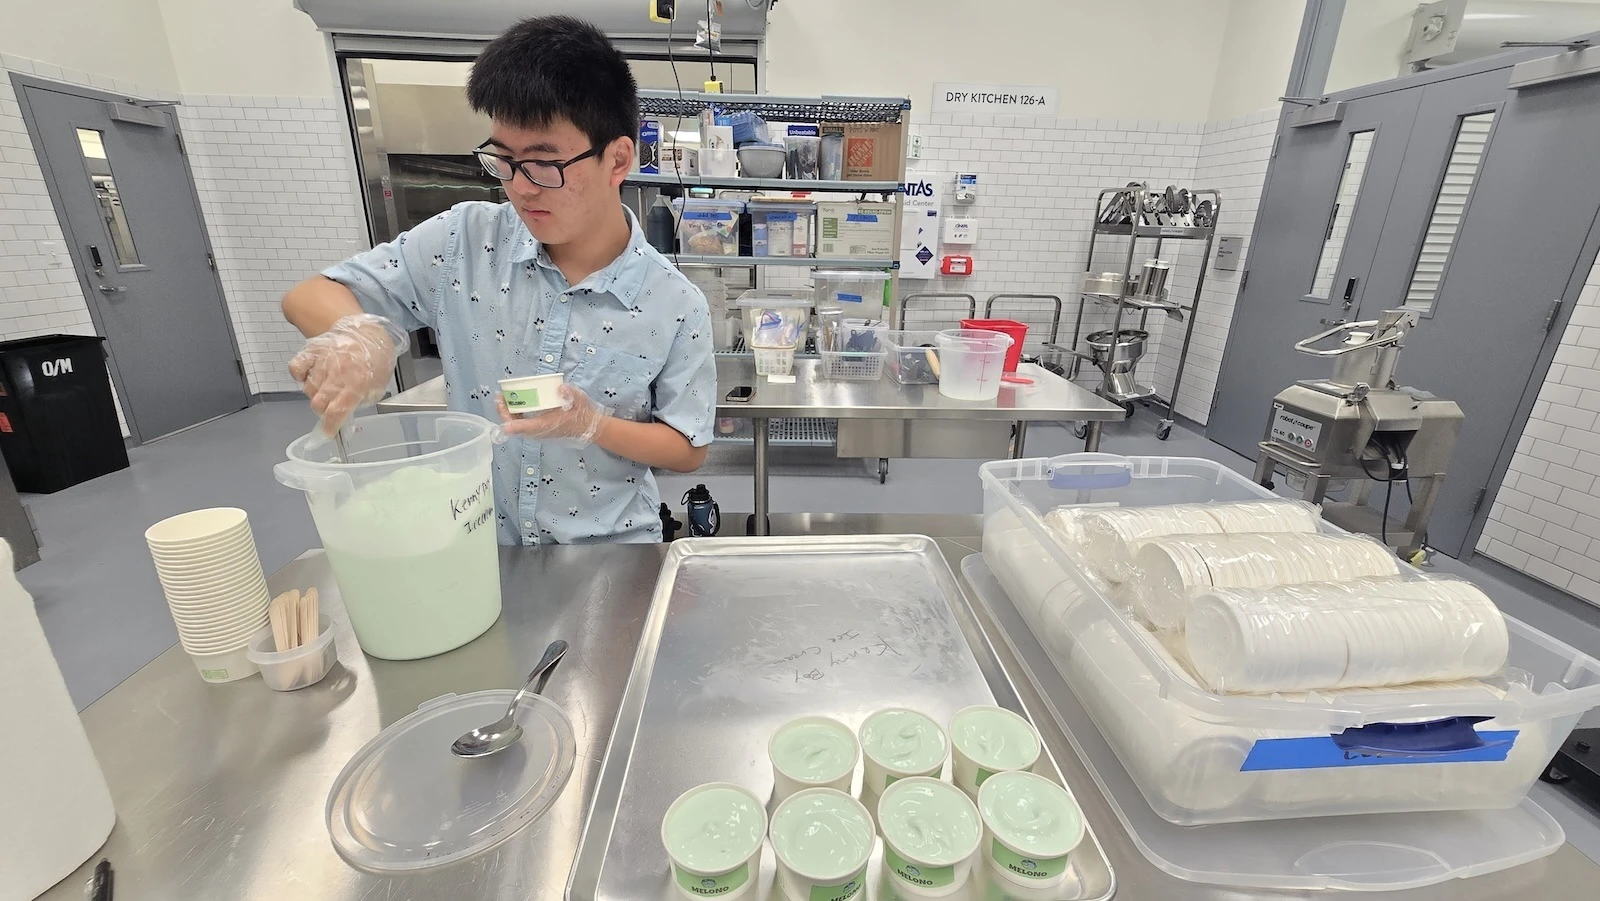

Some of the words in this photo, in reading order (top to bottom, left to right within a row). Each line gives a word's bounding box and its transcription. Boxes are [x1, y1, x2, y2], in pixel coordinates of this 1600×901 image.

[946, 92, 968, 102] DRY
[970, 93, 1017, 105] KITCHEN
[1020, 95, 1046, 106] 126-A
[789, 128, 817, 136] Unbeatable
[848, 139, 874, 166] HOME
[41, 358, 73, 377] O/M
[827, 629, 860, 642] Ice
[773, 646, 822, 664] Cream
[830, 634, 902, 667] Kenny
[897, 868, 933, 886] MELONO
[1008, 863, 1048, 877] MELONO
[691, 886, 729, 895] MELONO
